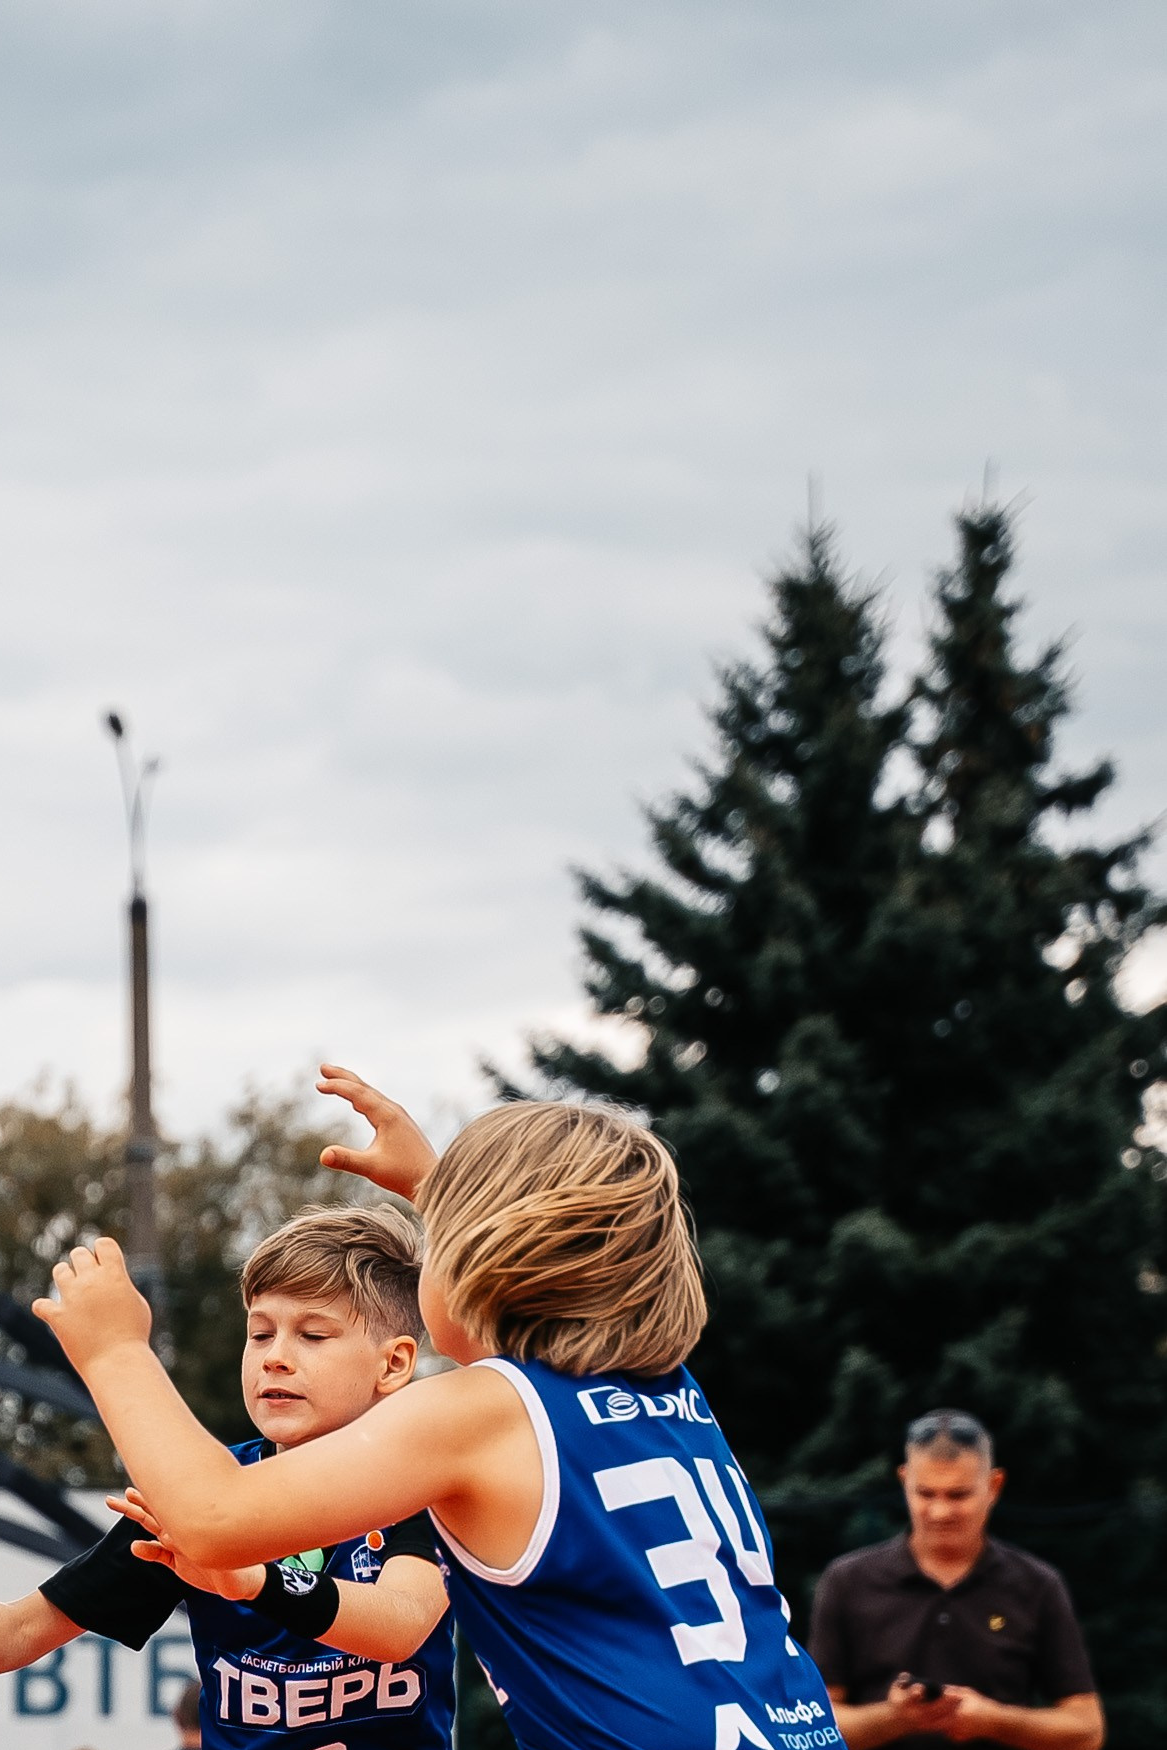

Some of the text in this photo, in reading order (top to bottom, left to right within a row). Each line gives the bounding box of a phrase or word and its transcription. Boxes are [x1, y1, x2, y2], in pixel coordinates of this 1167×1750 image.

[240, 1653, 345, 1675] БАСКЕТБОЛЬНЫЙ
[212, 1656, 422, 1728] ТВЕРЬ
[764, 1698, 826, 1725] Альфа
